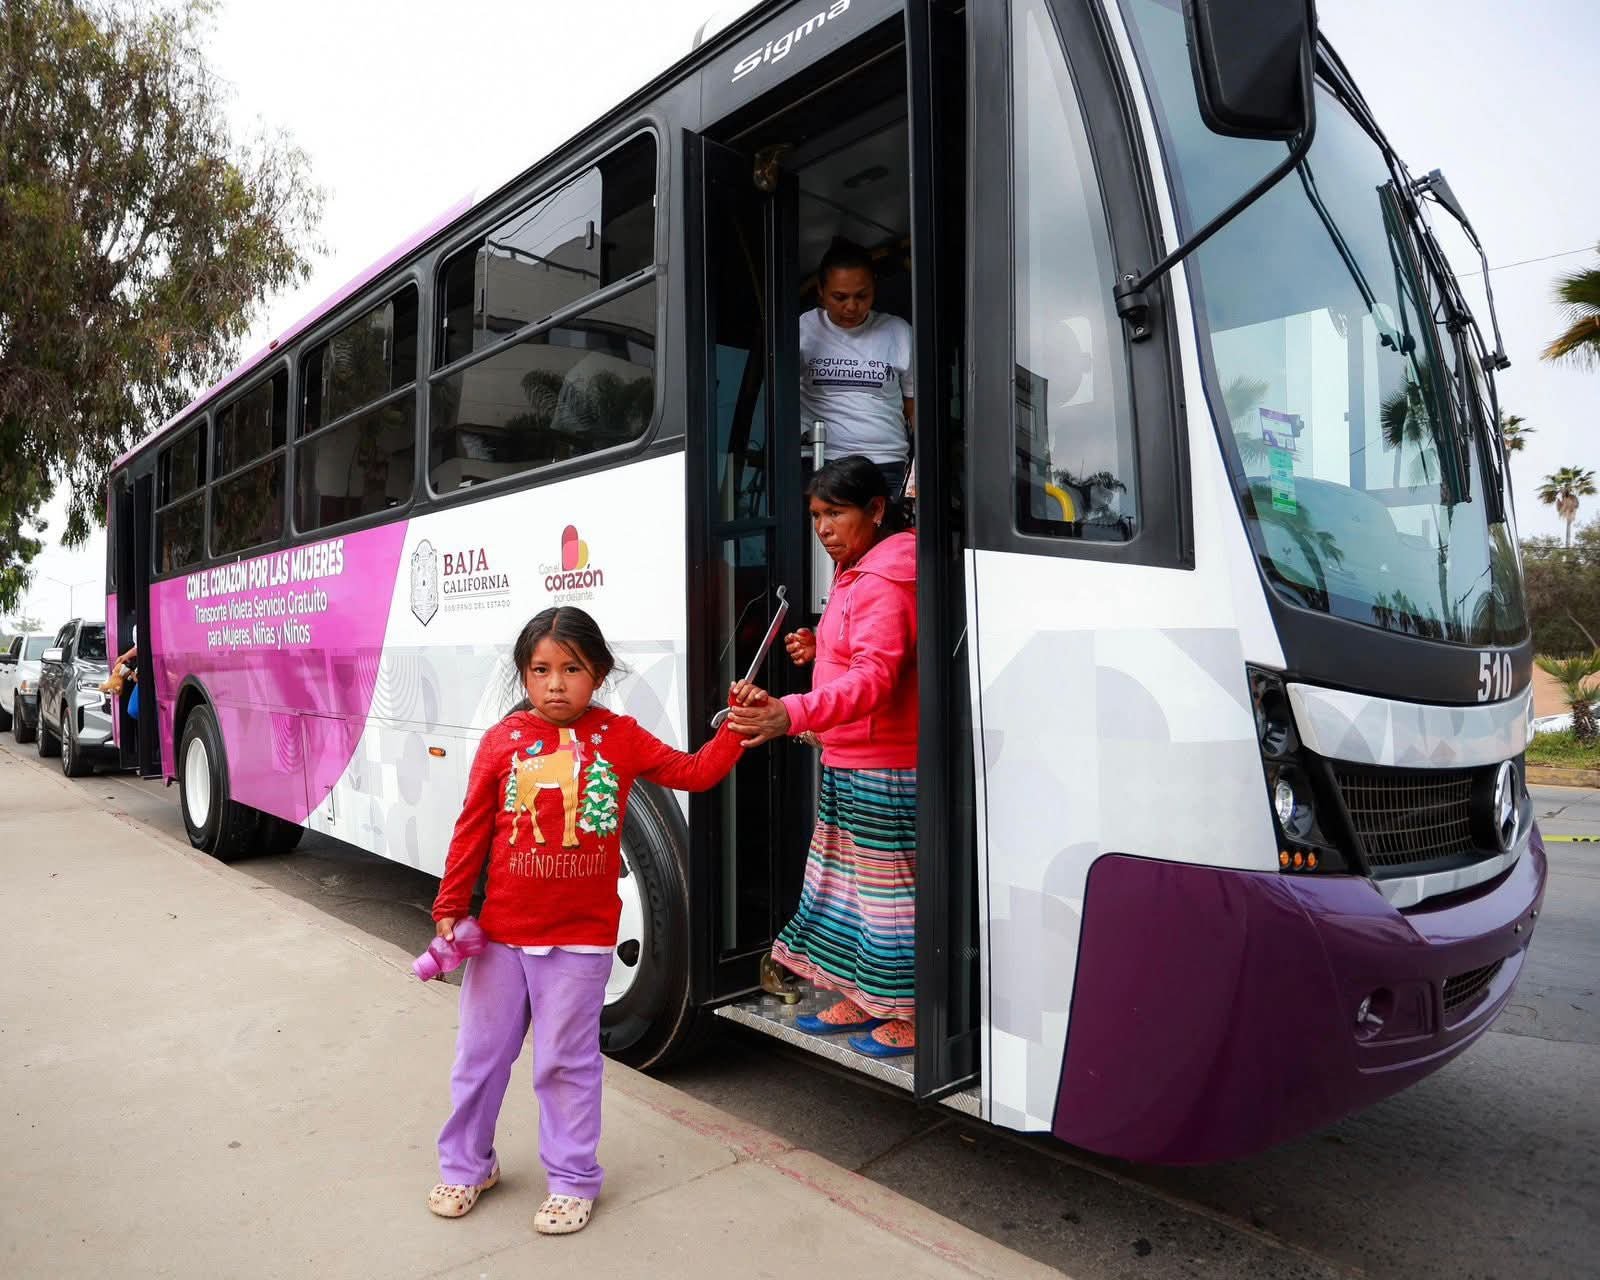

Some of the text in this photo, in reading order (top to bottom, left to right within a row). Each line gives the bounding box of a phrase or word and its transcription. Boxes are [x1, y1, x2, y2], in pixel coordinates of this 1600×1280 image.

[731, 0, 850, 83] Sigma
[808, 366, 884, 380] movimiento
[868, 360, 885, 368] en
[186, 539, 344, 600] CON EL CORAZÓN POR LAS MUJERES
[443, 547, 489, 576] BAJA
[443, 574, 509, 594] CALIFORNIA
[545, 563, 604, 592] corazón
[195, 584, 328, 627] Transporte Violeta Servicio Gratuito
[207, 618, 311, 651] para Mujeres, Niñas y Niños
[1478, 652, 1513, 702] 510
